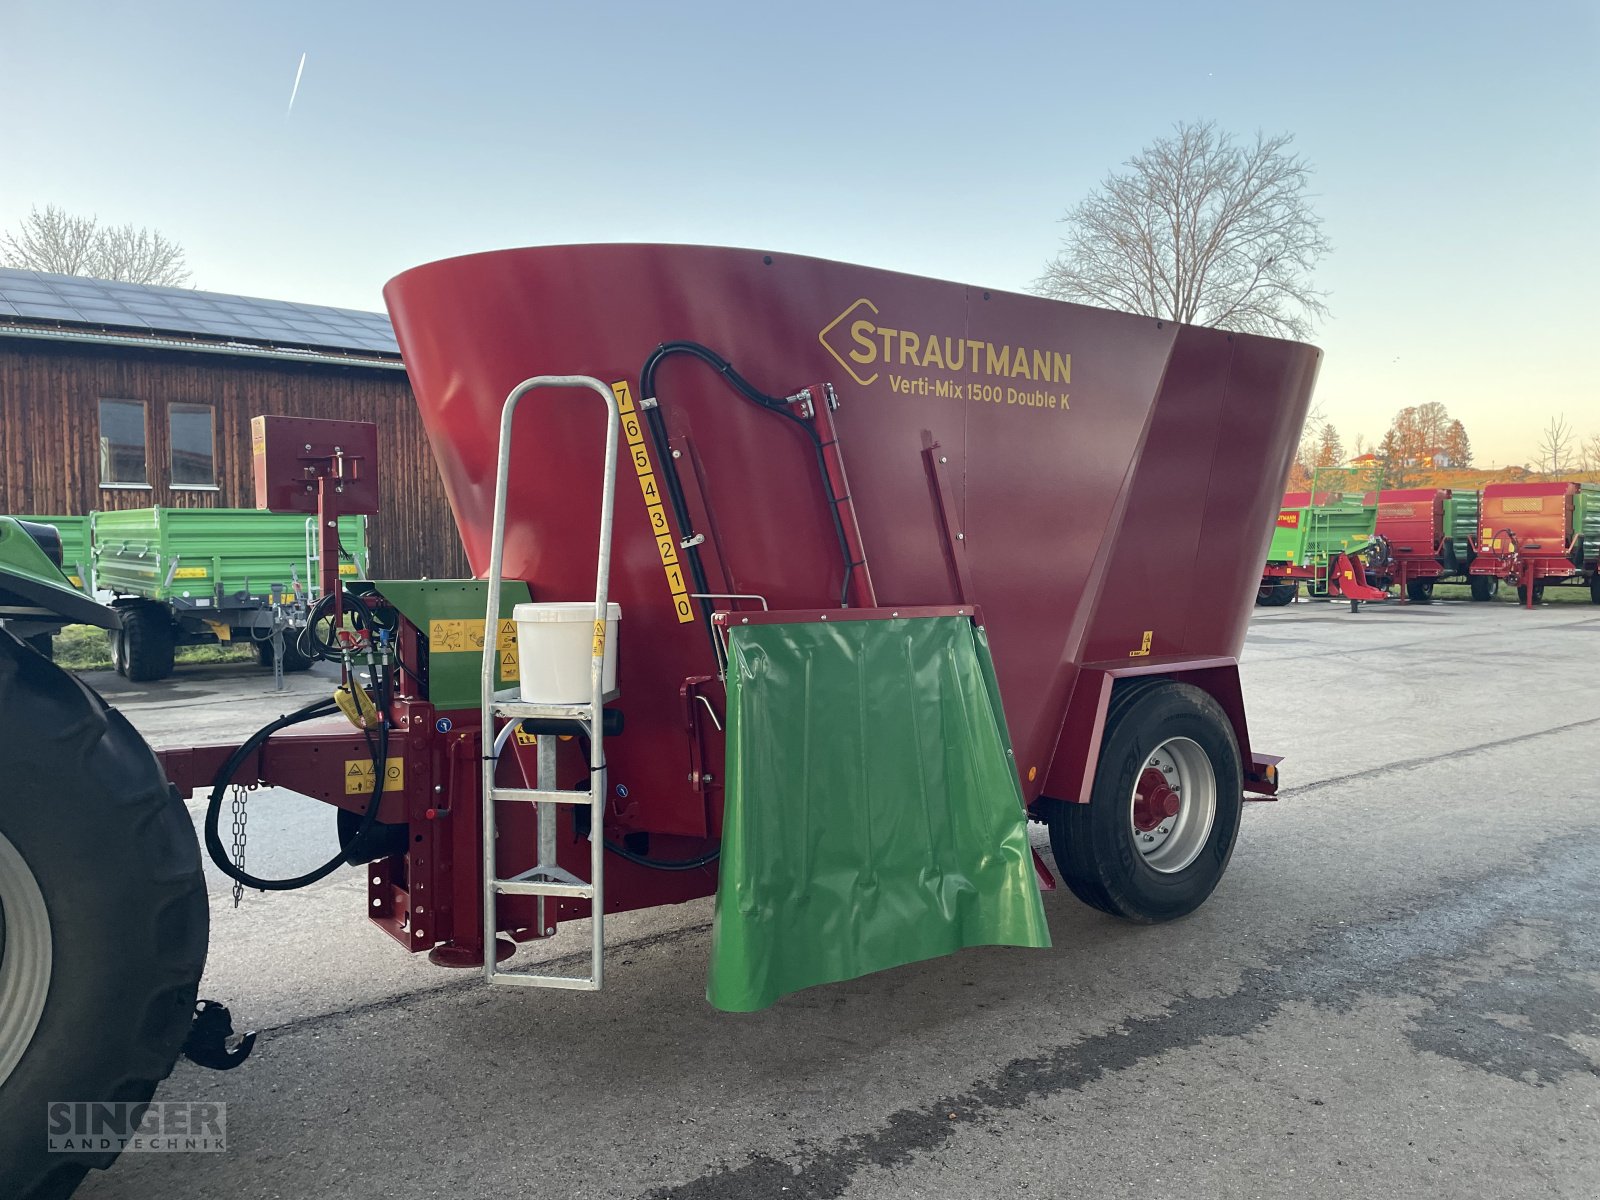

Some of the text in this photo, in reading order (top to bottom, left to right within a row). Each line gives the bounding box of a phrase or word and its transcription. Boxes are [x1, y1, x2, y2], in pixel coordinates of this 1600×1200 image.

[849, 320, 1072, 384] STRAUTMANN
[616, 389, 627, 405] 7
[889, 375, 1070, 410] Verti-Mix 1500 Double K
[627, 420, 638, 436] 6
[636, 451, 646, 467] 5
[645, 481, 656, 498] 4
[653, 512, 664, 528] 3
[661, 542, 673, 558] 2
[671, 572, 680, 587] 1
[678, 600, 689, 616] 0
